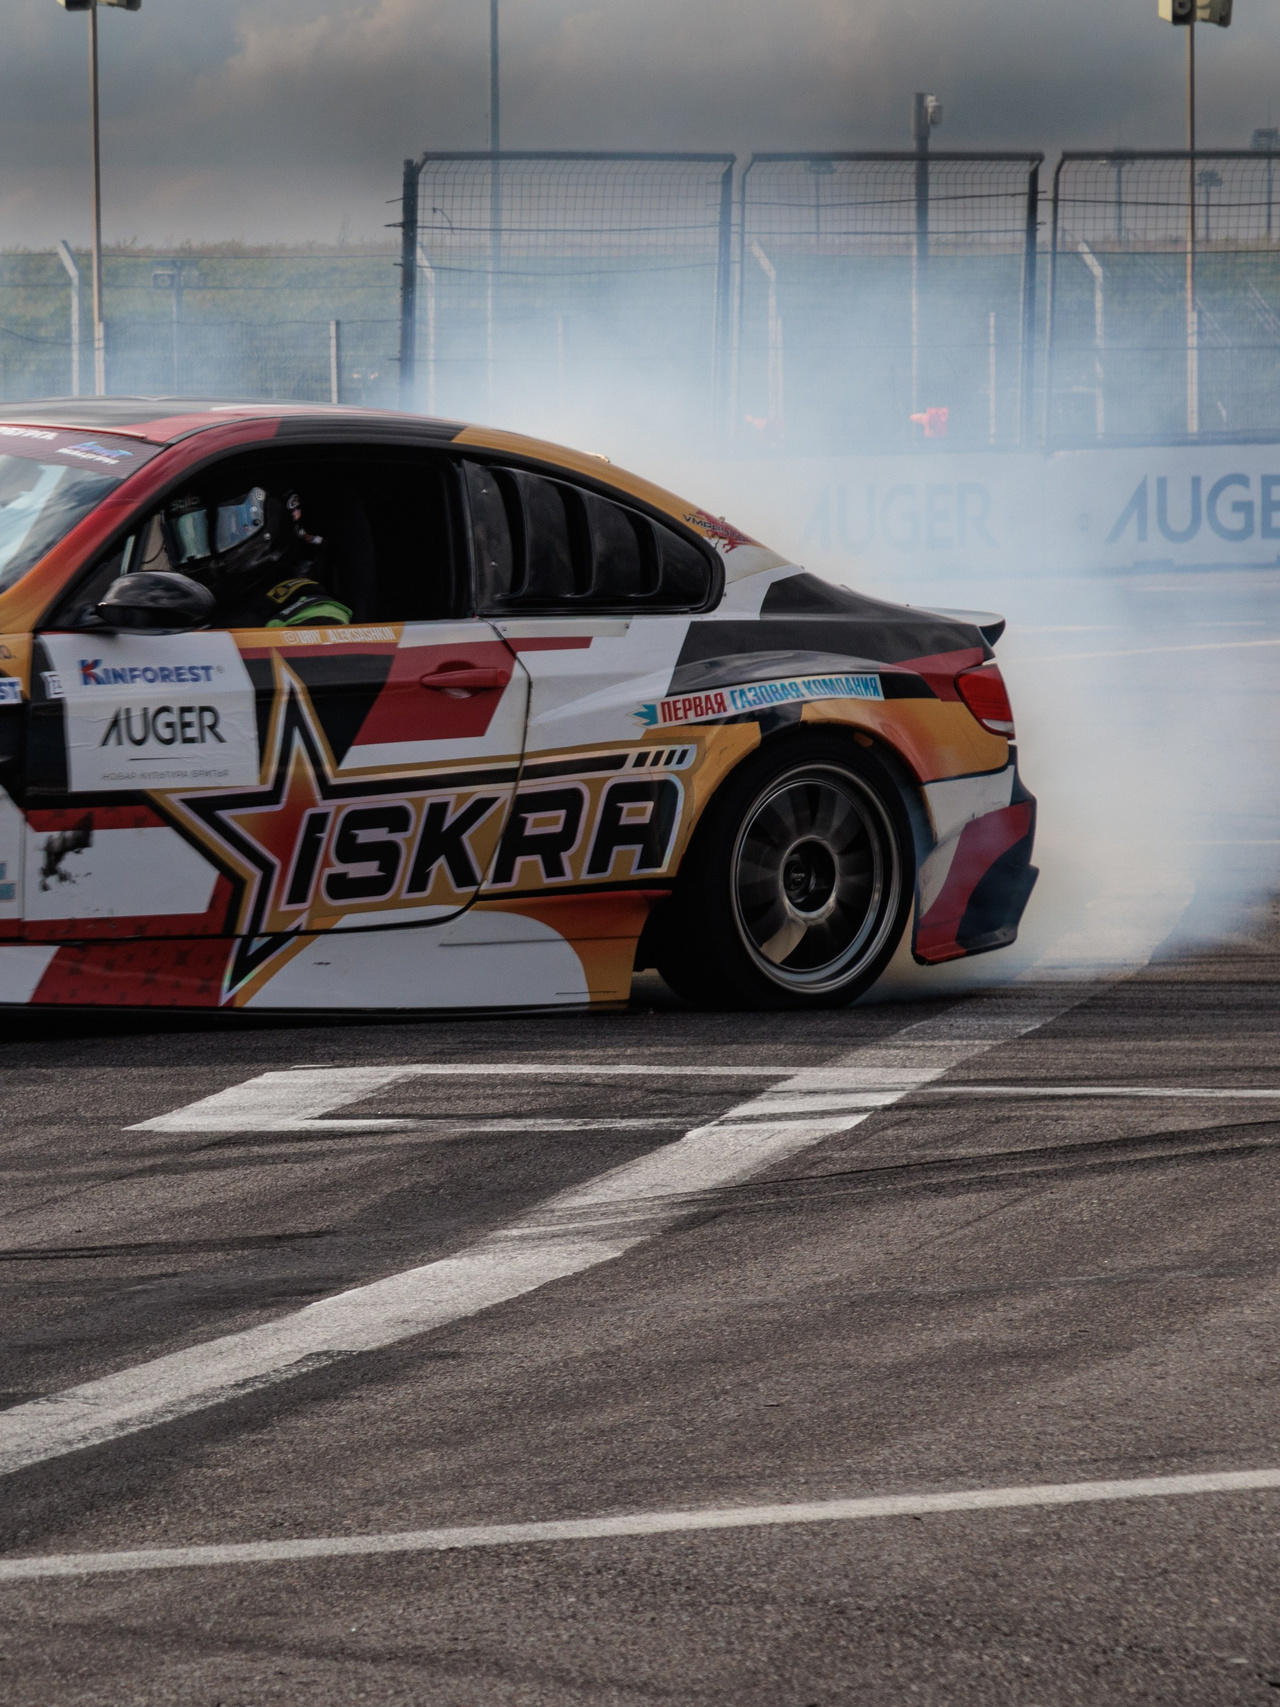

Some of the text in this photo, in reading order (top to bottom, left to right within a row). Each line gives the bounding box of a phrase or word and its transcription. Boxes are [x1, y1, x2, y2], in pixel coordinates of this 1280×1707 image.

[799, 482, 999, 554] AUGER
[79, 658, 214, 686] KINFOREST
[660, 676, 881, 723] ПЕРВАЯ ГАЗОВАЯ КОМПАНИЯ
[100, 705, 227, 746] AUGER
[282, 776, 683, 908] ISKRA
